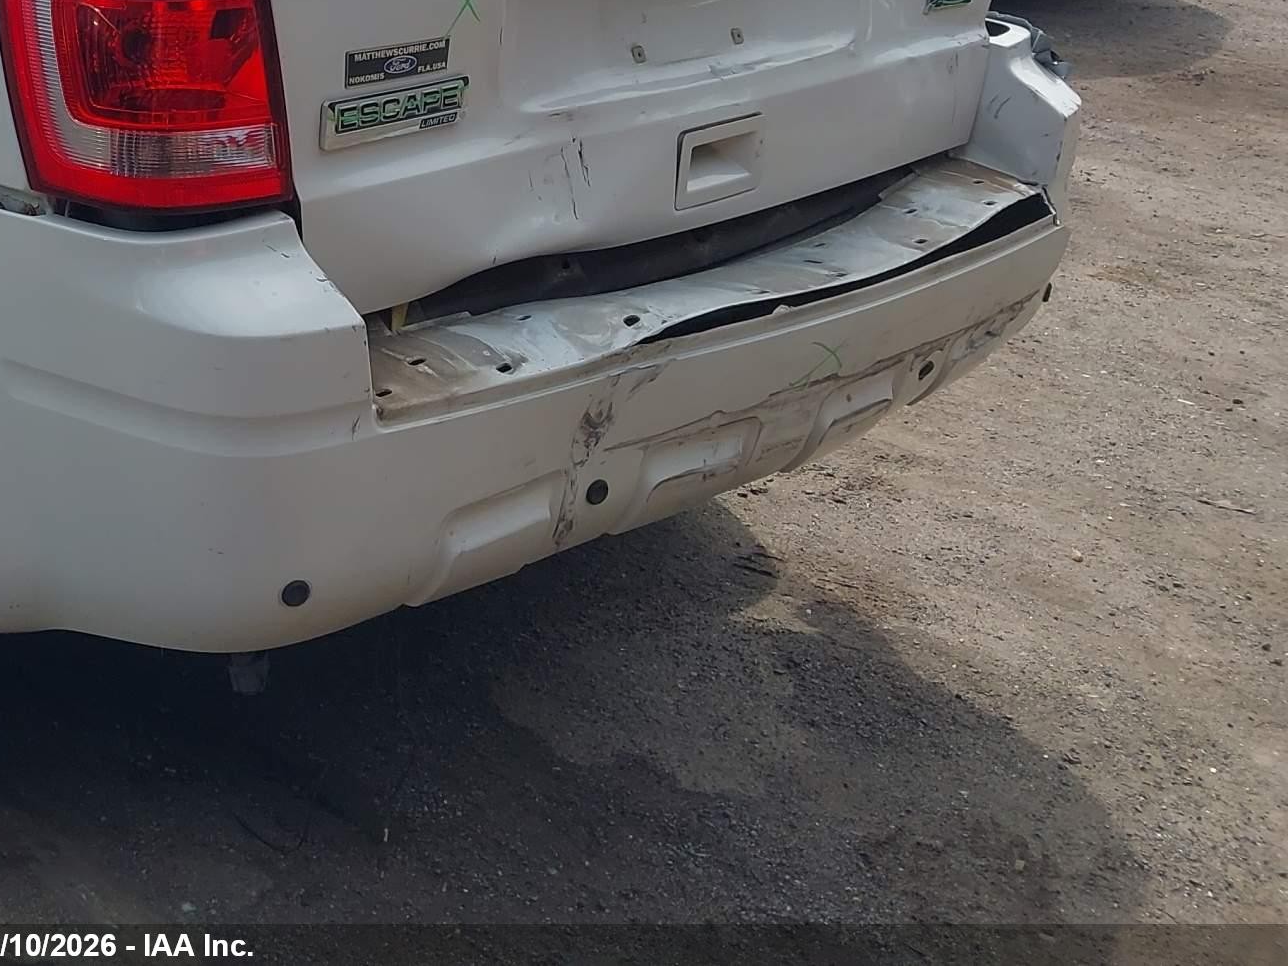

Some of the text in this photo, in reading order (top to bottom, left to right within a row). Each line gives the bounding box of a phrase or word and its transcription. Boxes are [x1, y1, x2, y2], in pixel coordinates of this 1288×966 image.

[354, 40, 446, 62] MATTHEWSCURRIE.COM
[348, 72, 385, 84] NOKOMIS
[337, 84, 462, 131] ESCAPE
[421, 113, 456, 128] LIMITED
